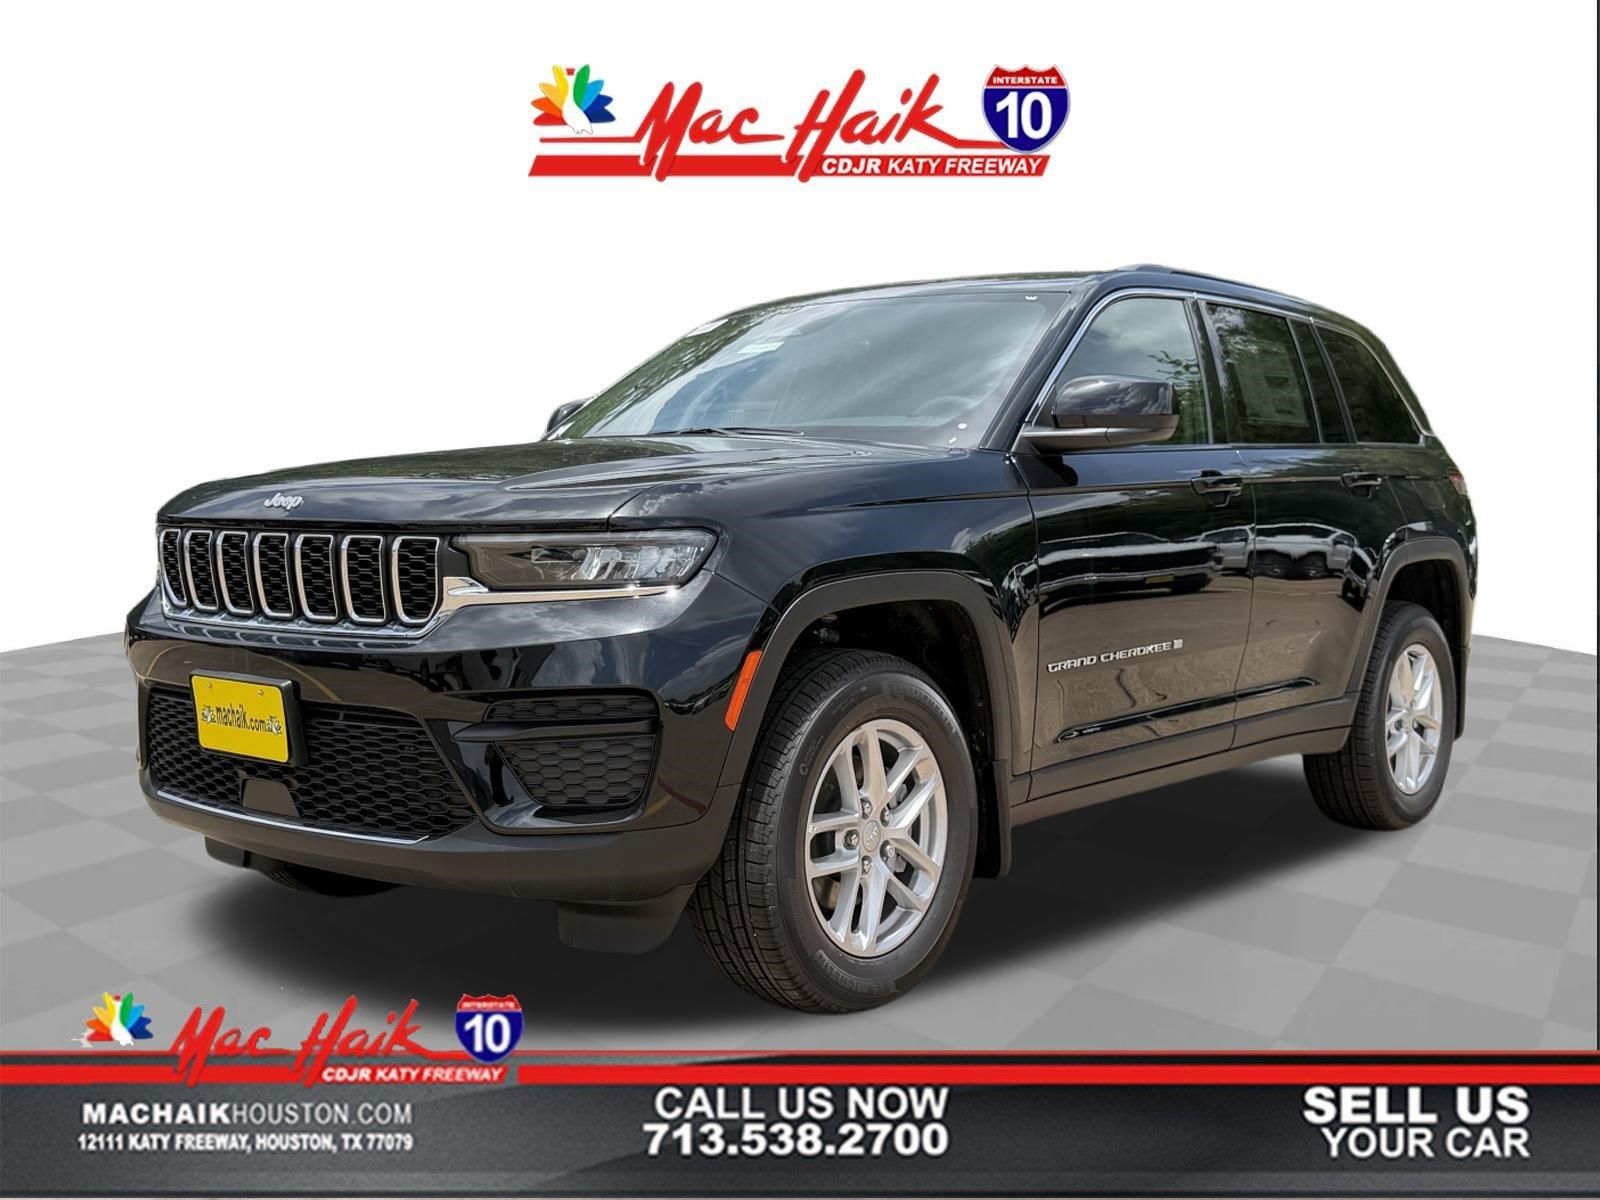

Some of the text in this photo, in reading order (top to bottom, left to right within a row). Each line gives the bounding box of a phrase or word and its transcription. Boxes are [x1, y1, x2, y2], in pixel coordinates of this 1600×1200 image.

[264, 492, 304, 510] Jeep
[1047, 641, 1173, 673] GRAND CHEROKEE
[215, 703, 267, 733] machaik.com
